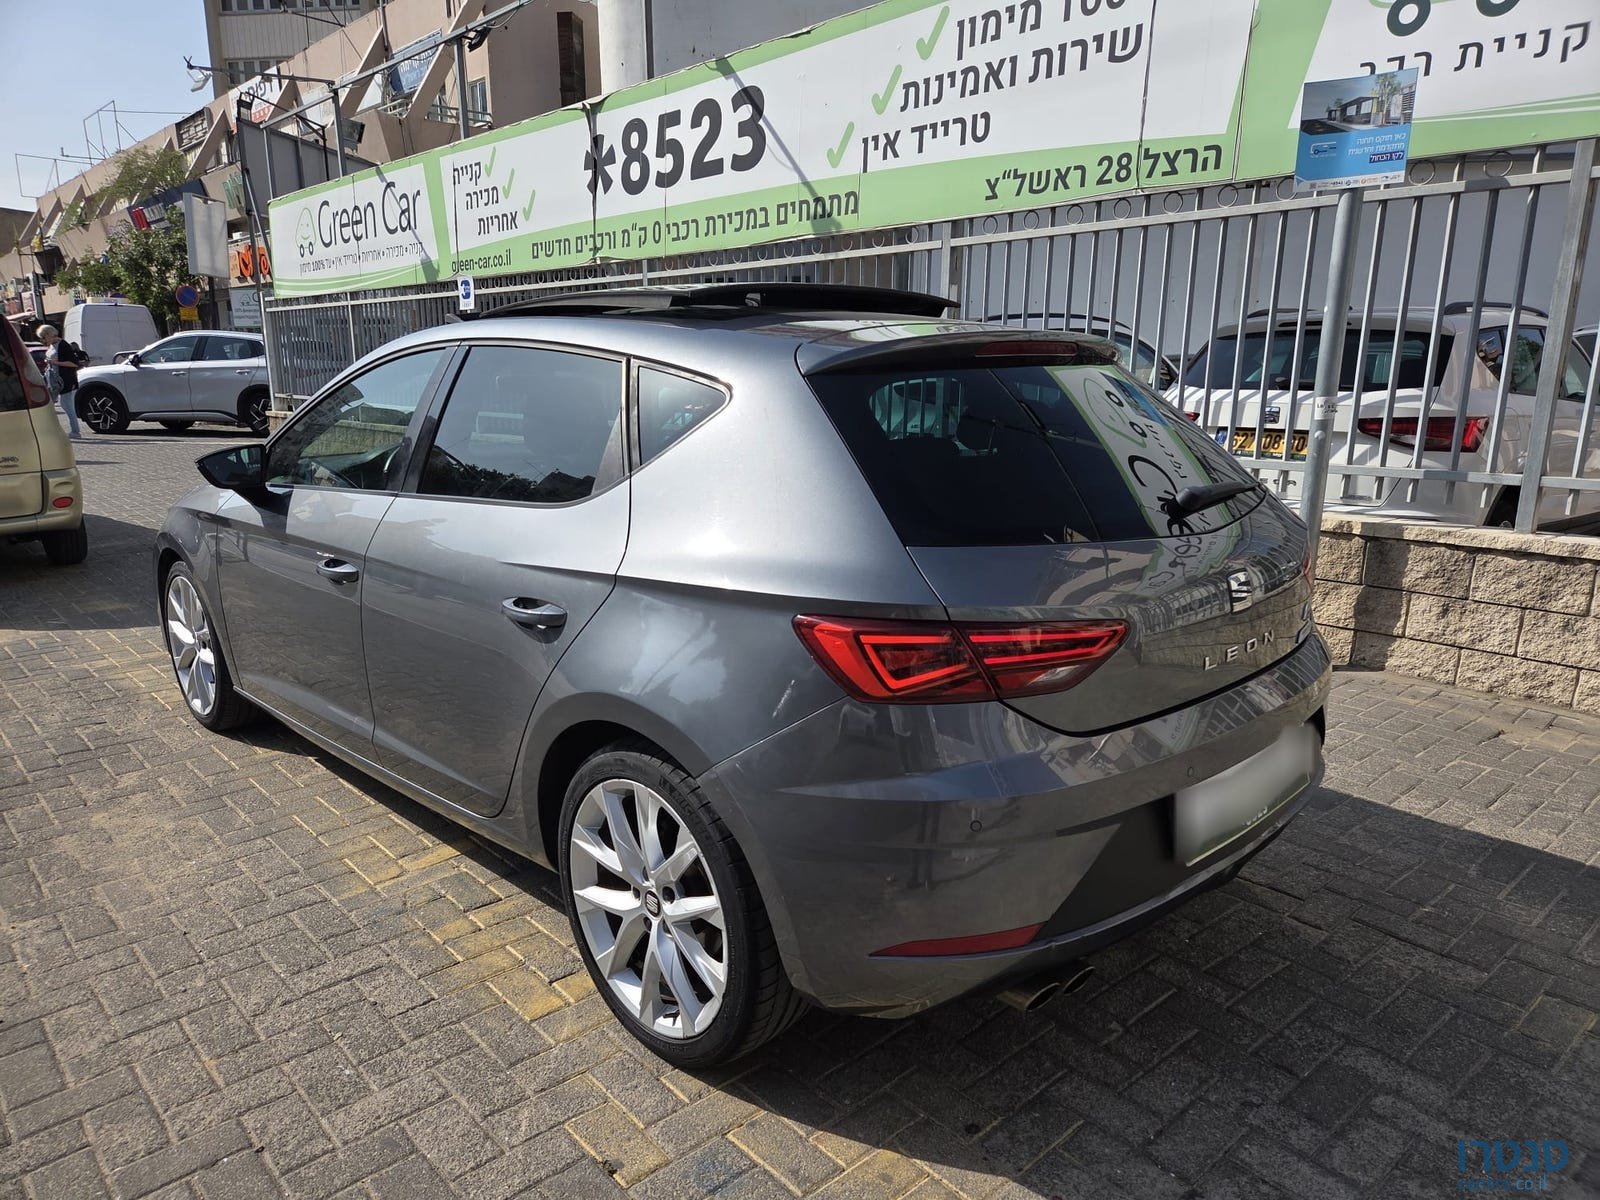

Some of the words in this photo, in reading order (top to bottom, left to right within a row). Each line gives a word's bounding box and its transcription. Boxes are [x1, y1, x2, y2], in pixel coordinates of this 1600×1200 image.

[956, 0, 1041, 61] מימון
[1453, 20, 1592, 73] קניית
[1028, 23, 1144, 84] שירות
[899, 54, 1019, 113] ואמינות
[910, 111, 991, 155] טרייד
[861, 129, 902, 174] אין
[1095, 152, 1133, 186] 28
[1143, 143, 1223, 180] הרצל
[452, 161, 482, 187] קניית
[318, 199, 377, 249] Green
[381, 181, 421, 236] Car
[465, 185, 499, 211] מכירה
[776, 190, 860, 226] מתמחים
[478, 210, 518, 236] אחריות
[665, 217, 699, 243] רכבי
[704, 207, 770, 238] במכירת
[531, 238, 571, 260] חדשים
[575, 230, 616, 254] ורכבים
[452, 248, 511, 273] geen-car.co.il
[1203, 629, 1276, 671] LEON
